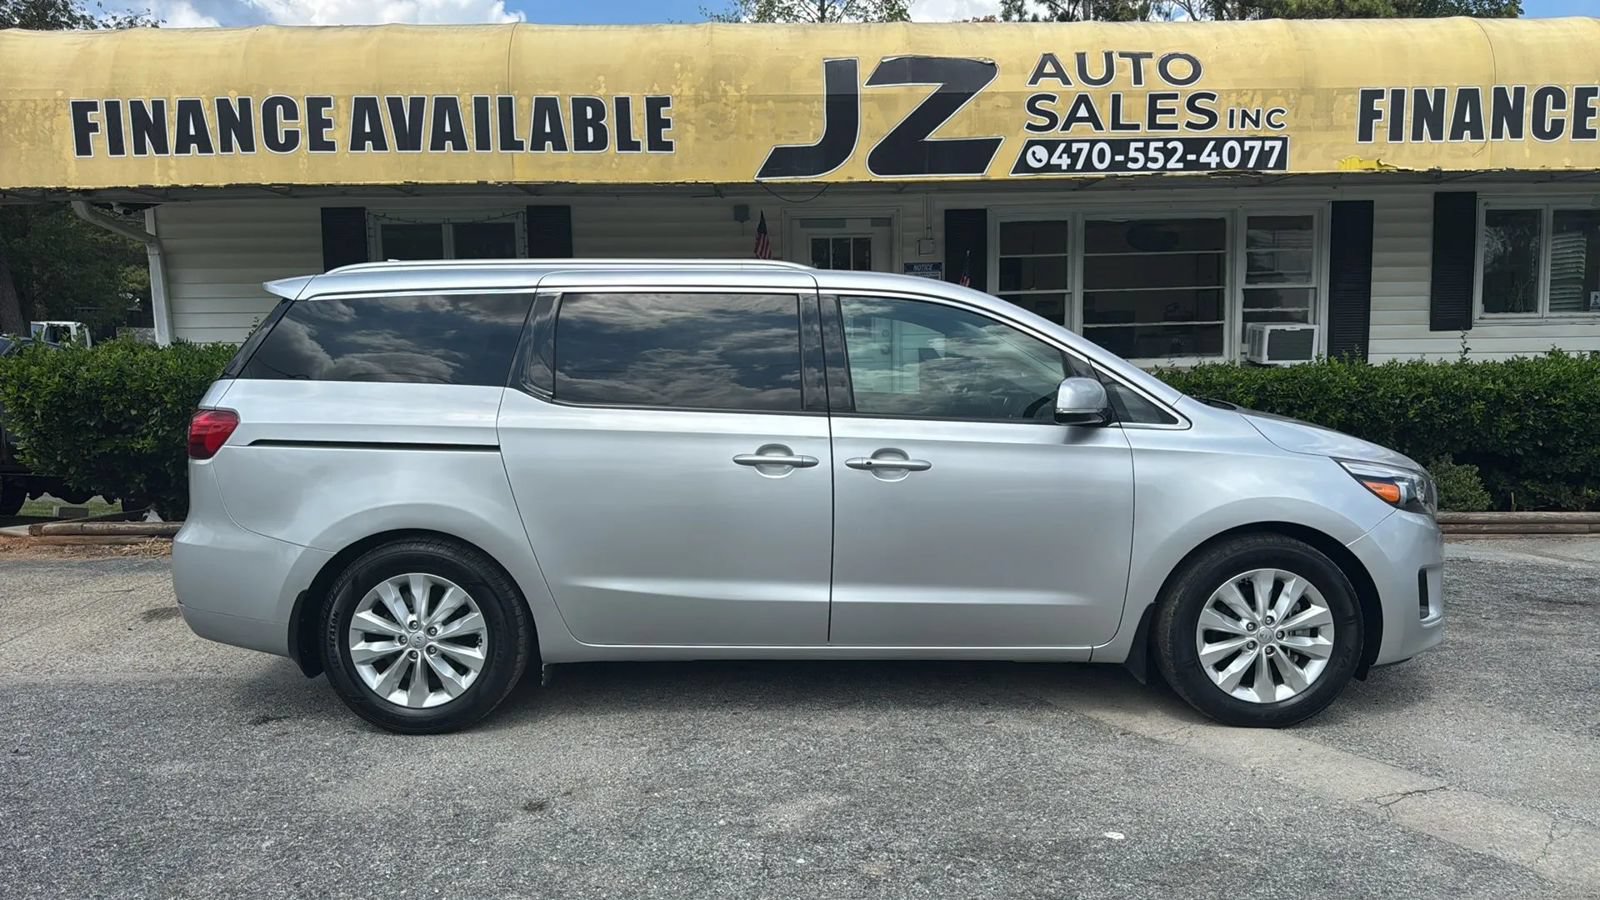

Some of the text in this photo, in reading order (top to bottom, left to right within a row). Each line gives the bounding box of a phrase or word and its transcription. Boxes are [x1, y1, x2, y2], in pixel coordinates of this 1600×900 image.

[1027, 51, 1203, 87] AUTO
[70, 95, 675, 158] FINANCE AVAILABLE
[754, 56, 1006, 180] JZ
[1024, 92, 1288, 133] SALES INC
[1357, 85, 1600, 144] FINANCE
[1050, 140, 1283, 170] 470-552-4077
[912, 264, 934, 272] NOTICE
